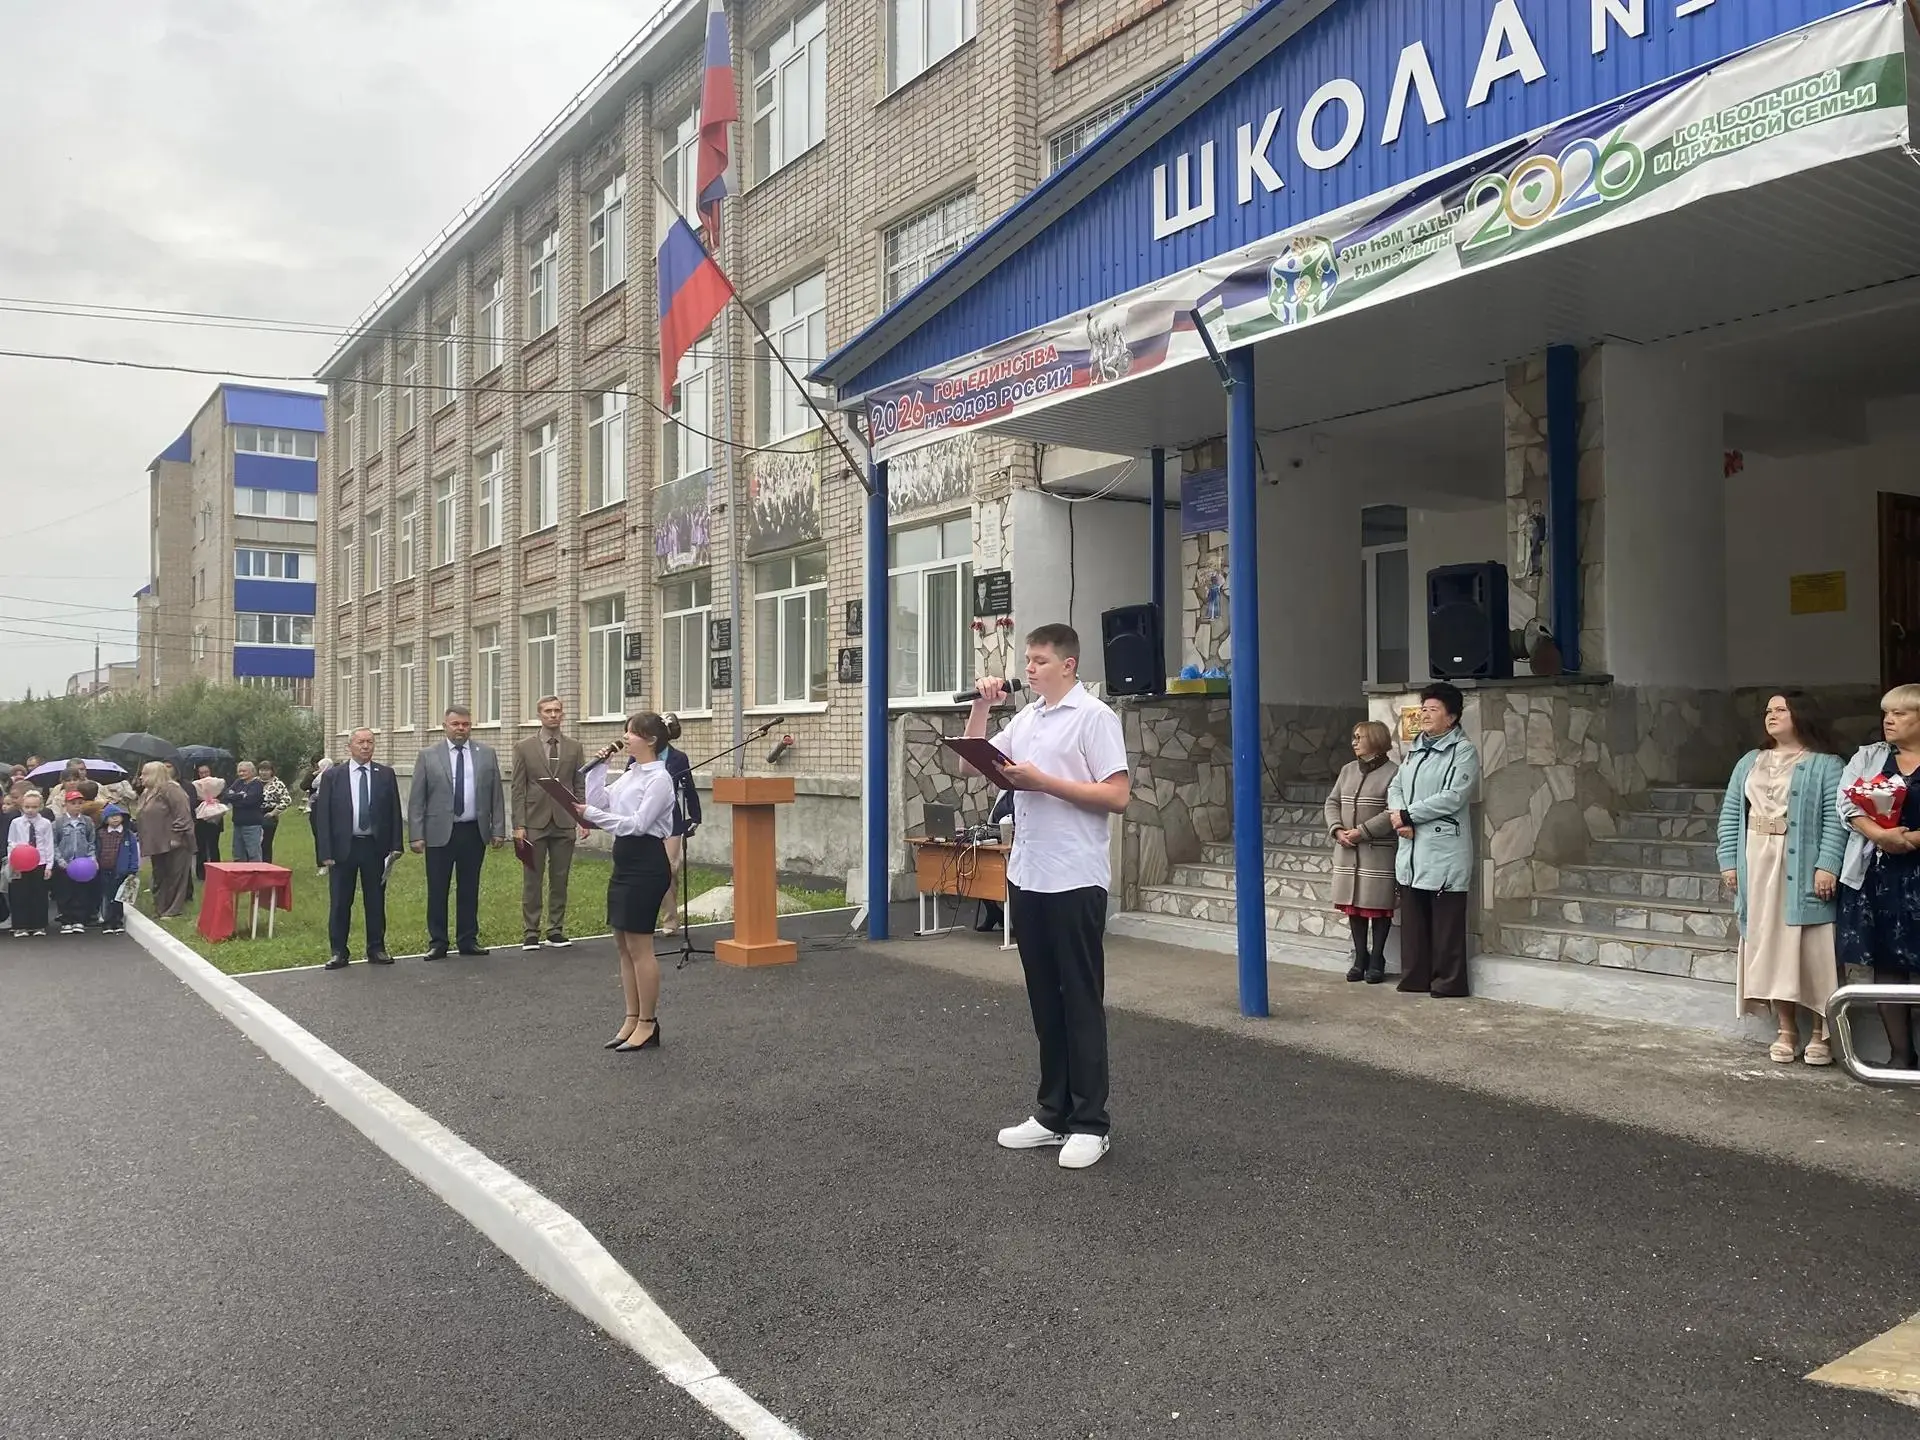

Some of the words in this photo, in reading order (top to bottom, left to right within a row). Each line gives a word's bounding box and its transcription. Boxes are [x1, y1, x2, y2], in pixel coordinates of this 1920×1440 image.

[1153, 0, 1547, 241] ШКОЛА
[1655, 153, 1671, 173] И
[1674, 115, 1783, 168] ДРУЖНОЙ
[1787, 83, 1876, 130] СЕМЬИ
[1675, 113, 1719, 145] ГОД
[1721, 70, 1839, 128] БОЛЬШОЙ
[1463, 125, 1644, 249] 2026
[1407, 207, 1462, 239] ТАТЫУ
[924, 392, 997, 430] НАРОДОВ
[1001, 365, 1073, 406] РОССИИ
[934, 380, 964, 402] ГОД
[968, 344, 1059, 390] ЕДИНСТВА
[872, 391, 925, 439] 2026
